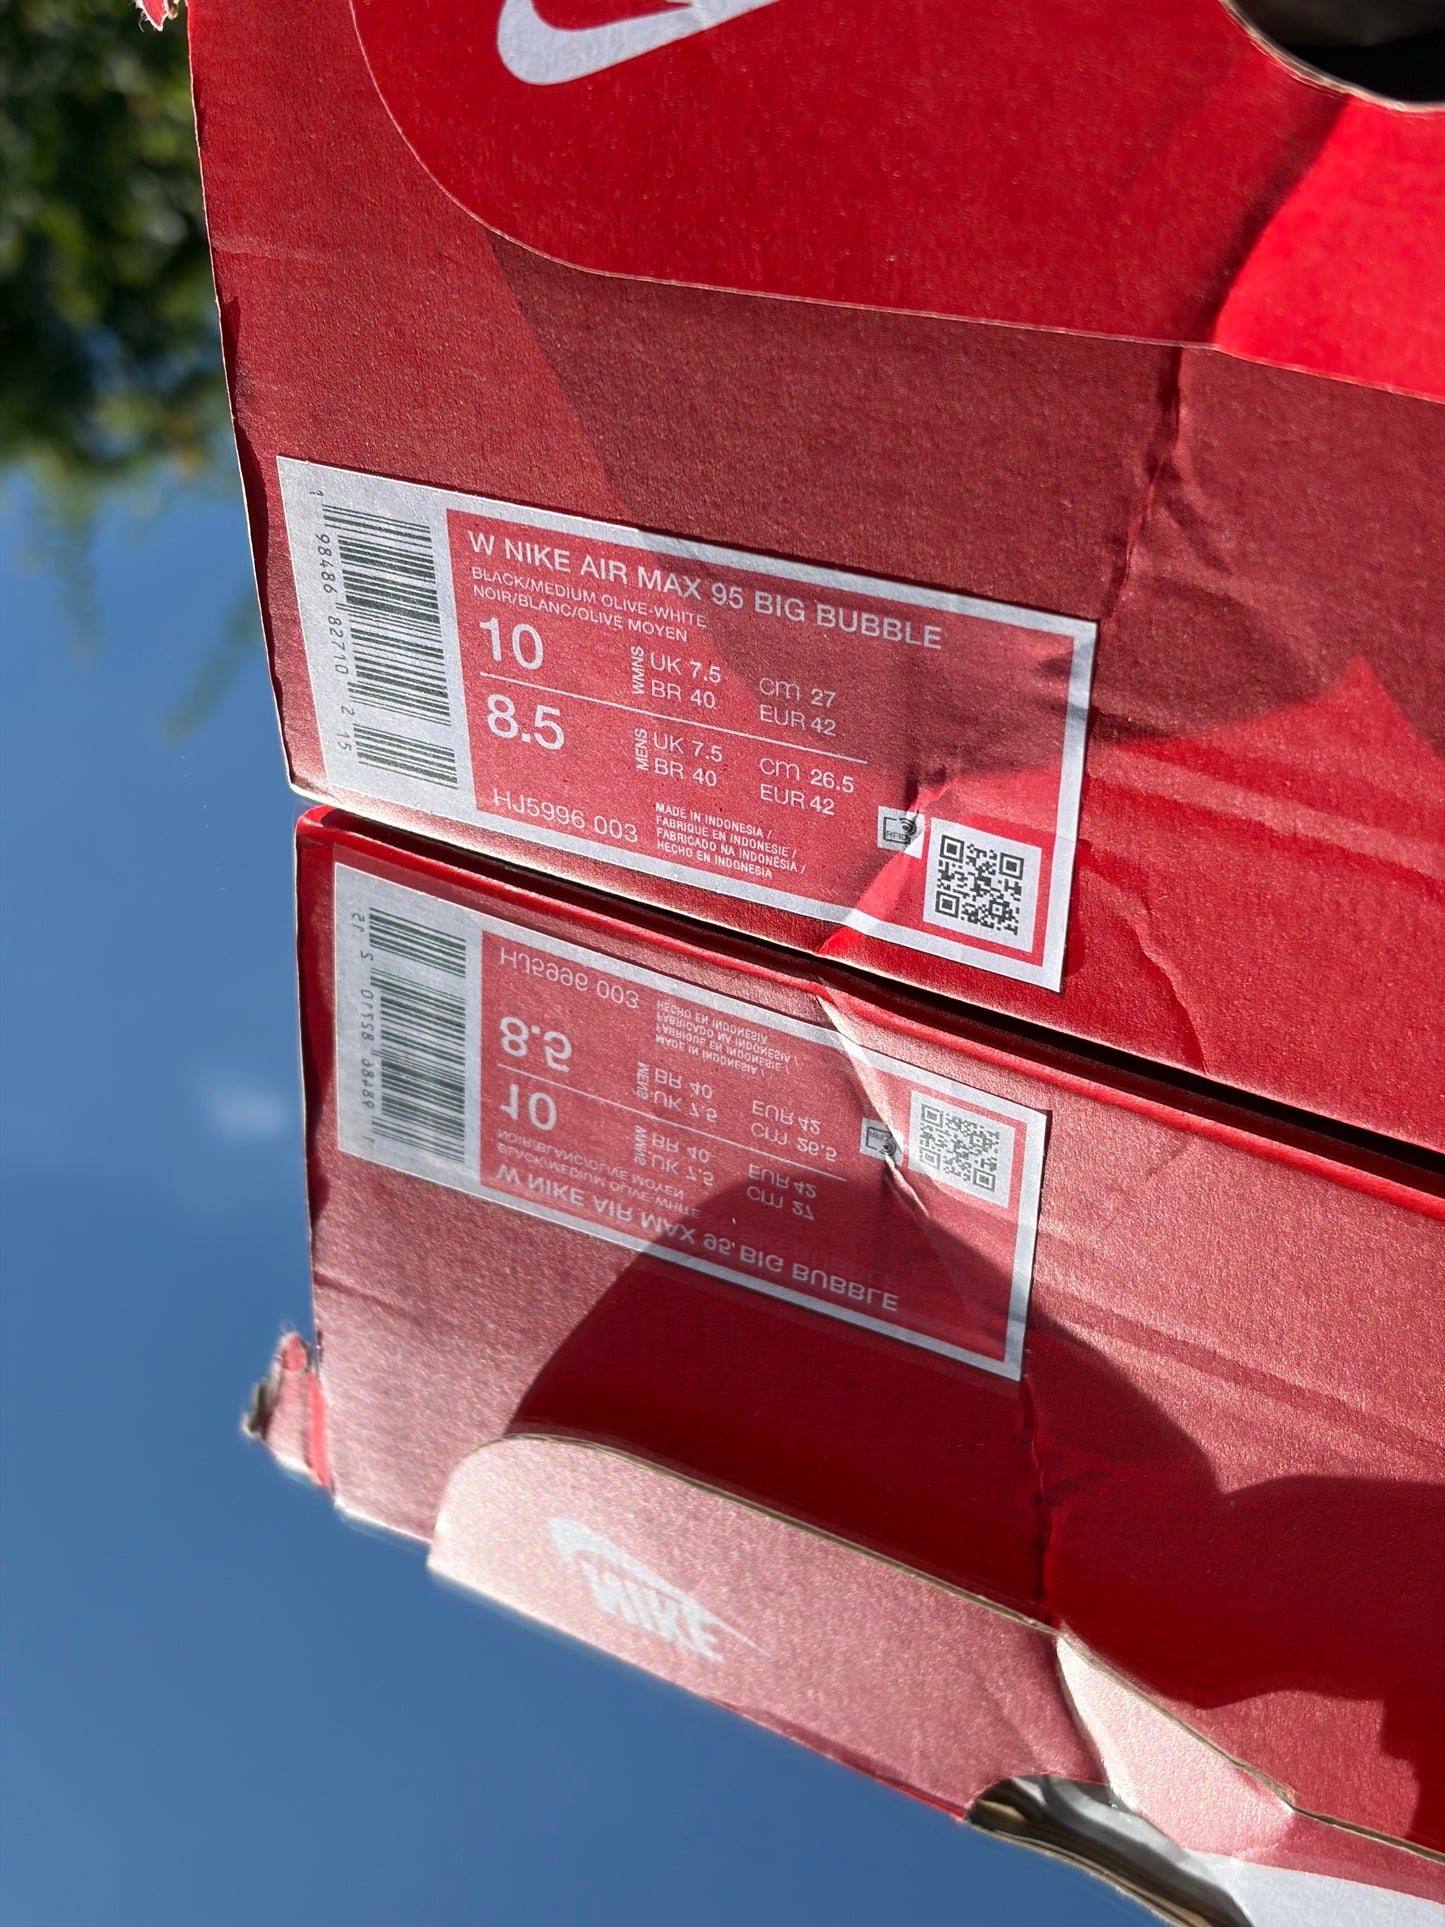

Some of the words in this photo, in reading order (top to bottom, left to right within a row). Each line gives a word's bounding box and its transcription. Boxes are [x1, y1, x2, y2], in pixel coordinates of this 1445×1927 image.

[309, 489, 324, 497] 1
[315, 533, 336, 595] 98486
[468, 530, 494, 555] W
[505, 539, 571, 572] NIKE
[581, 556, 627, 584] AIR
[639, 566, 701, 599] MAX
[711, 582, 743, 608] 95
[754, 591, 805, 622] BIG
[816, 604, 941, 649] BUBBLE
[472, 567, 595, 604] BLACK/MEDIUM
[601, 595, 706, 628] OLIVE-WHITE
[474, 585, 623, 629] NOIR/BLANC/OLIVE
[628, 619, 687, 642] MOYEN
[328, 615, 350, 676] 82710
[480, 617, 544, 670] 10
[630, 646, 645, 696] WMNS
[650, 653, 682, 675] UK
[690, 661, 721, 683] 7.5
[341, 705, 355, 717] 2
[651, 680, 682, 701] BR
[690, 690, 715, 709] 40
[811, 688, 836, 708] 27
[487, 694, 565, 750] 8.5
[760, 704, 805, 730] EUR
[811, 717, 836, 736] 42
[335, 732, 352, 752] 15
[634, 728, 649, 772] MENS
[653, 732, 684, 754] UK
[692, 740, 722, 763] 7.5
[654, 758, 684, 780] BR
[693, 768, 717, 787] 40
[810, 769, 855, 793] 26.5
[493, 787, 586, 829] HJ5996
[594, 815, 638, 843] 003
[760, 783, 805, 809] EUR
[810, 796, 835, 816] 42
[655, 802, 687, 819] MADE
[690, 811, 701, 822] IN
[705, 814, 764, 838] INDONESIA
[656, 815, 708, 837] FABRIQUE
[712, 829, 726, 842] EN
[730, 834, 788, 857] INDONESIE
[656, 827, 716, 851] FABRICADO
[720, 844, 736, 857] NA
[656, 840, 693, 858] HECHO
[697, 850, 711, 863] EN
[714, 854, 773, 879] INDONESIA
